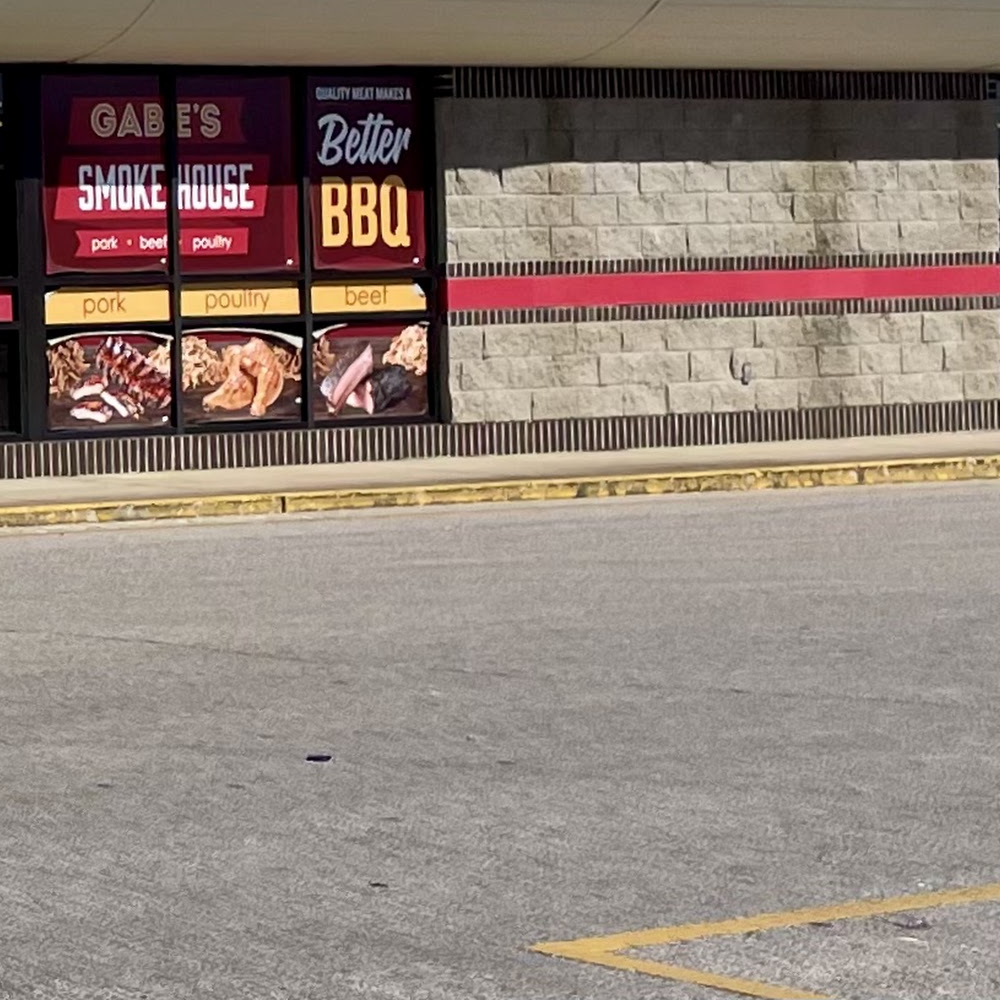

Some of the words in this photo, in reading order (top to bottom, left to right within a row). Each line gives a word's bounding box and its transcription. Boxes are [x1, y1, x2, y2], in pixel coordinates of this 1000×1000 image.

[90, 102, 222, 138] GABE'S
[316, 112, 412, 166] Better
[78, 164, 167, 211] SMOKE
[177, 163, 254, 210] HOUSE
[321, 174, 411, 248] BBQ
[91, 235, 118, 253] pork
[192, 234, 233, 253] poultry
[83, 292, 127, 316] pork
[205, 286, 270, 314] poultry
[344, 283, 389, 306] beef
